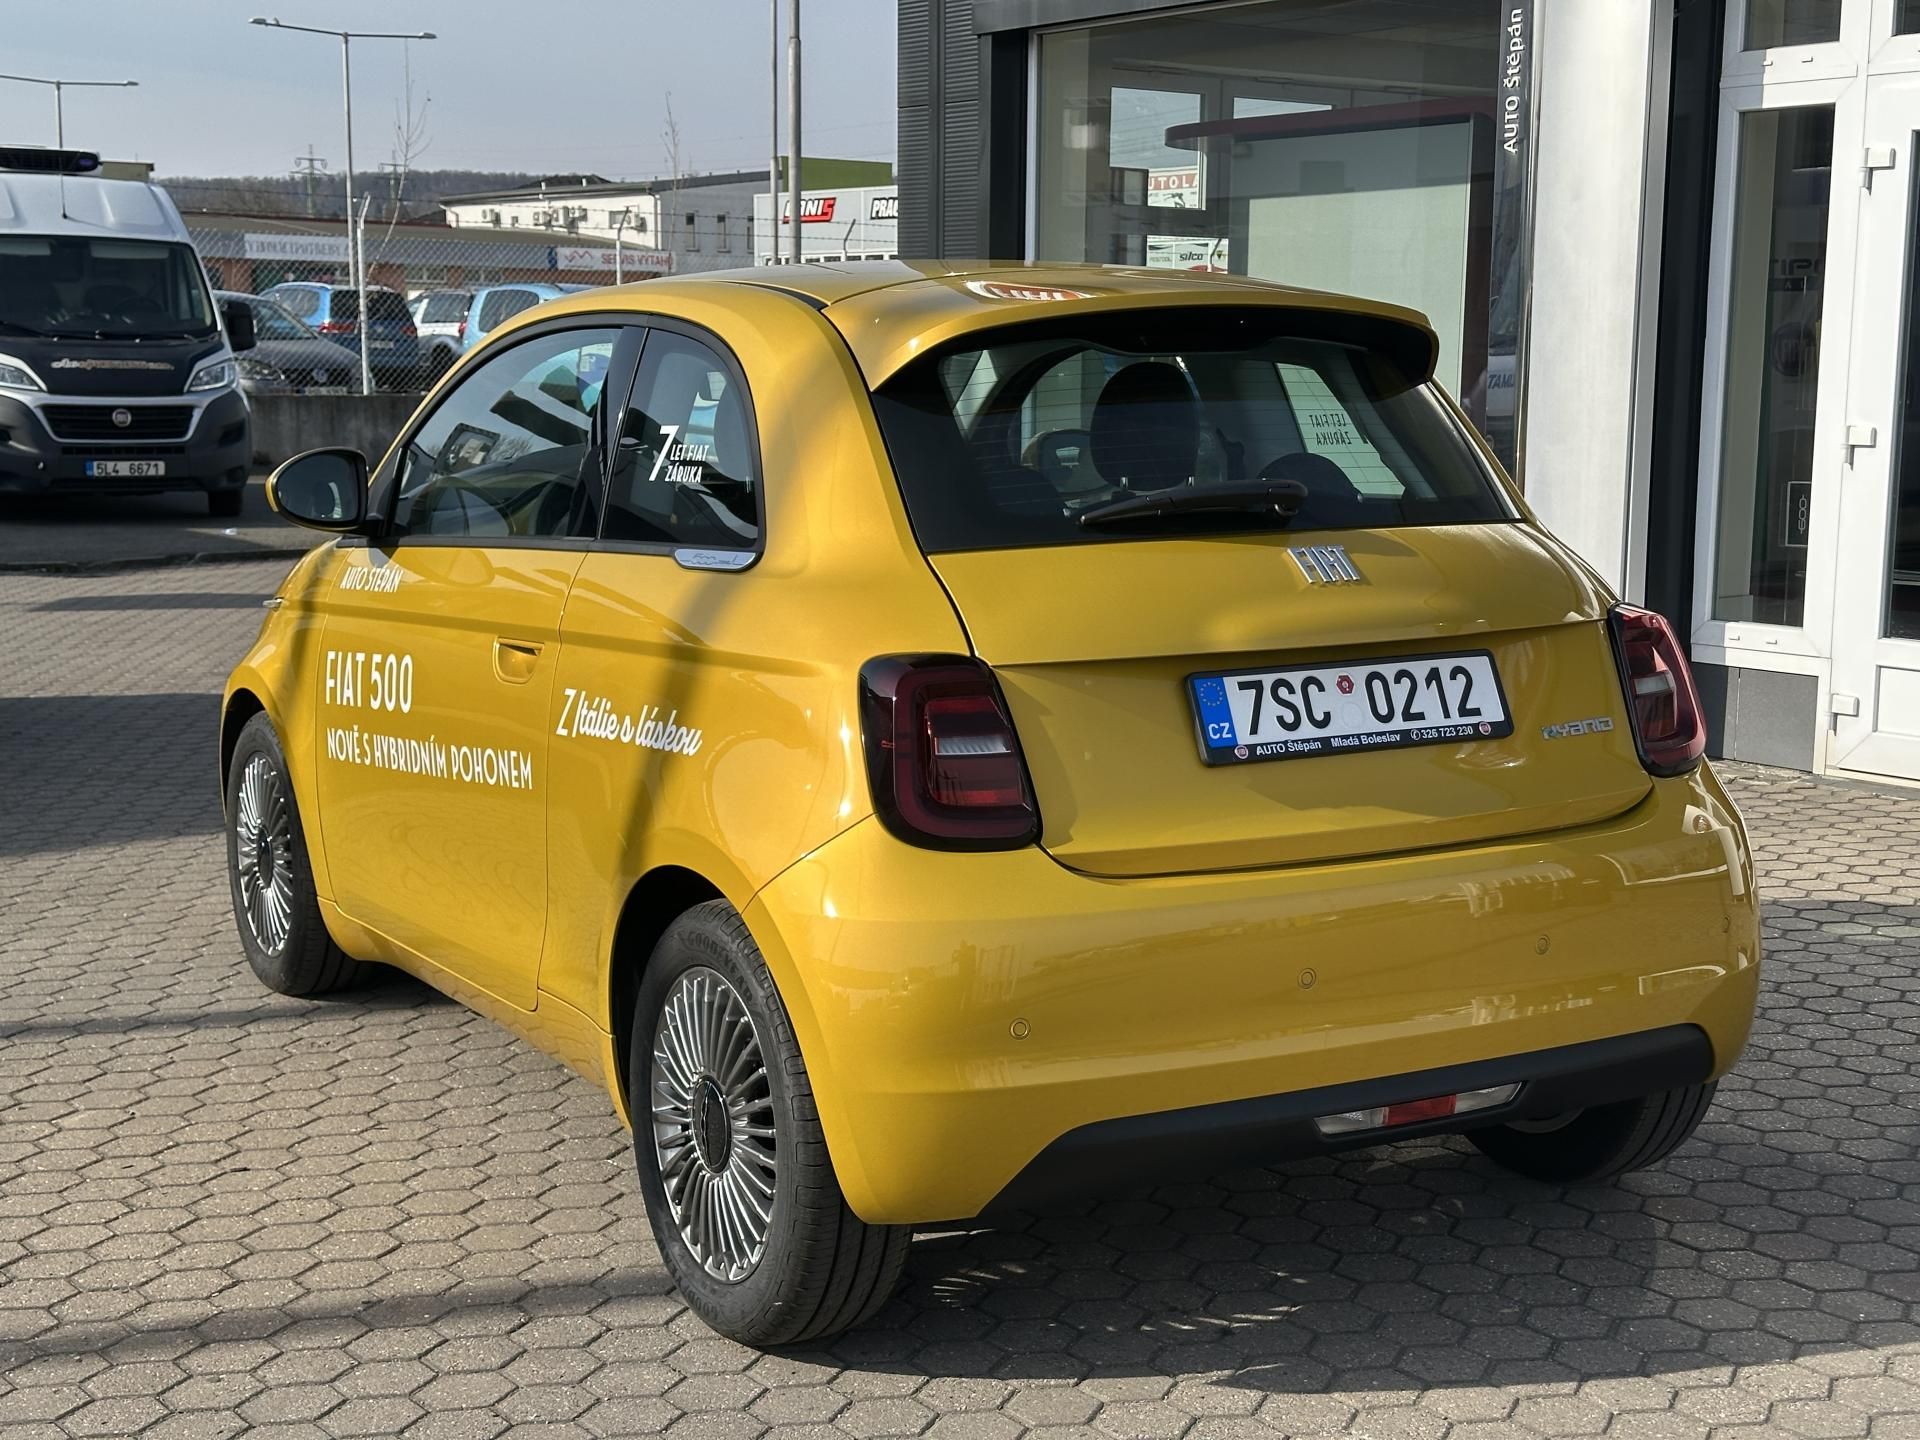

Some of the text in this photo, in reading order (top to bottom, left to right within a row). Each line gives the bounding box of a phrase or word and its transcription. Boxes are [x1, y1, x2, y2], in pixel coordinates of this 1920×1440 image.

[1502, 8, 1525, 155] AUTO Štěpán
[601, 252, 634, 267] SEVIS
[1179, 251, 1204, 261] silco
[648, 424, 680, 482] 7
[670, 443, 710, 462] LET FIAT
[96, 462, 120, 476] 5L4
[664, 462, 703, 483] ZÁRUKA
[340, 566, 369, 590] AUTO
[1287, 545, 1361, 584] FIAT
[326, 650, 413, 713] FIAT 500
[1237, 665, 1482, 737] 7SC 0212
[556, 687, 703, 757] Z Itálie s láskou
[1208, 722, 1233, 740] CZ
[1256, 743, 1286, 756] AUTO
[1287, 739, 1322, 753] Štěpán
[1330, 735, 1360, 748] Mladá
[1360, 732, 1401, 745] Boleslav
[1421, 728, 1438, 739] 326
[1439, 726, 1456, 738] 723
[1458, 725, 1474, 736] 230
[326, 724, 533, 790] NOVĚ S HYBRIDNÍM POHONEM
